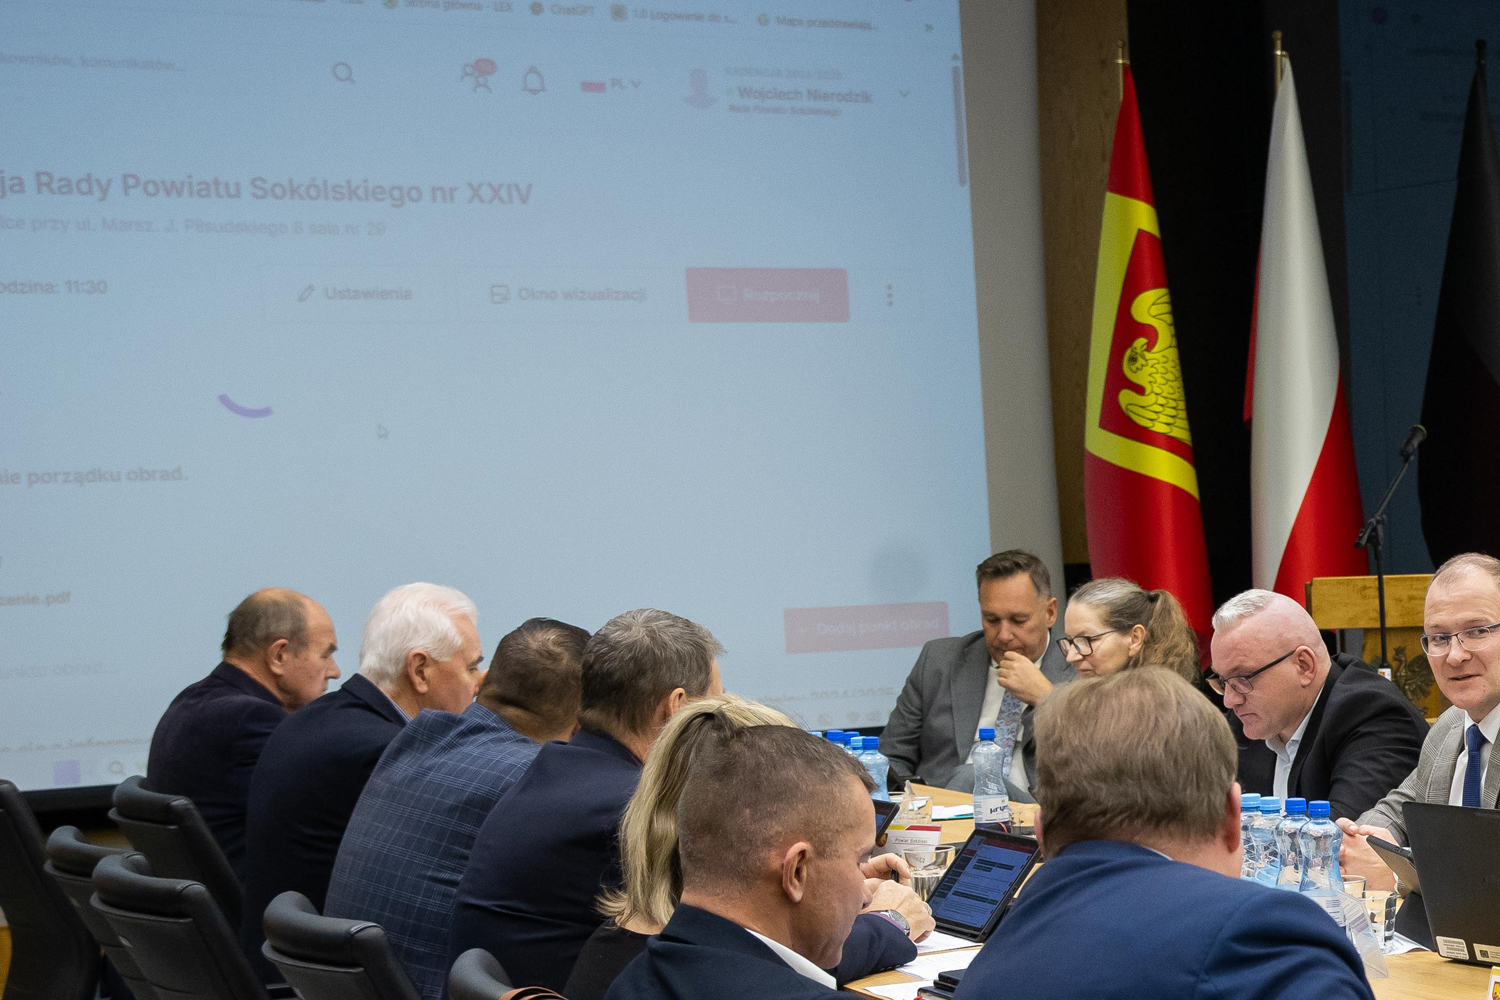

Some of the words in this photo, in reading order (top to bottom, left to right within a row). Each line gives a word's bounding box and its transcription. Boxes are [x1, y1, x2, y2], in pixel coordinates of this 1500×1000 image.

[737, 86, 803, 103] Wojciech
[35, 170, 113, 203] Rady
[121, 172, 242, 200] Powiatu
[250, 175, 423, 210] Sokólskiego
[430, 184, 459, 204] nr
[466, 181, 533, 205] XXIV
[31, 217, 70, 234] przy
[64, 279, 108, 295] 11:30
[324, 286, 412, 301] Ustawienia
[517, 286, 558, 301] Okno
[0, 468, 22, 485] ie
[27, 467, 122, 488] porządku
[126, 465, 189, 483] obrad.
